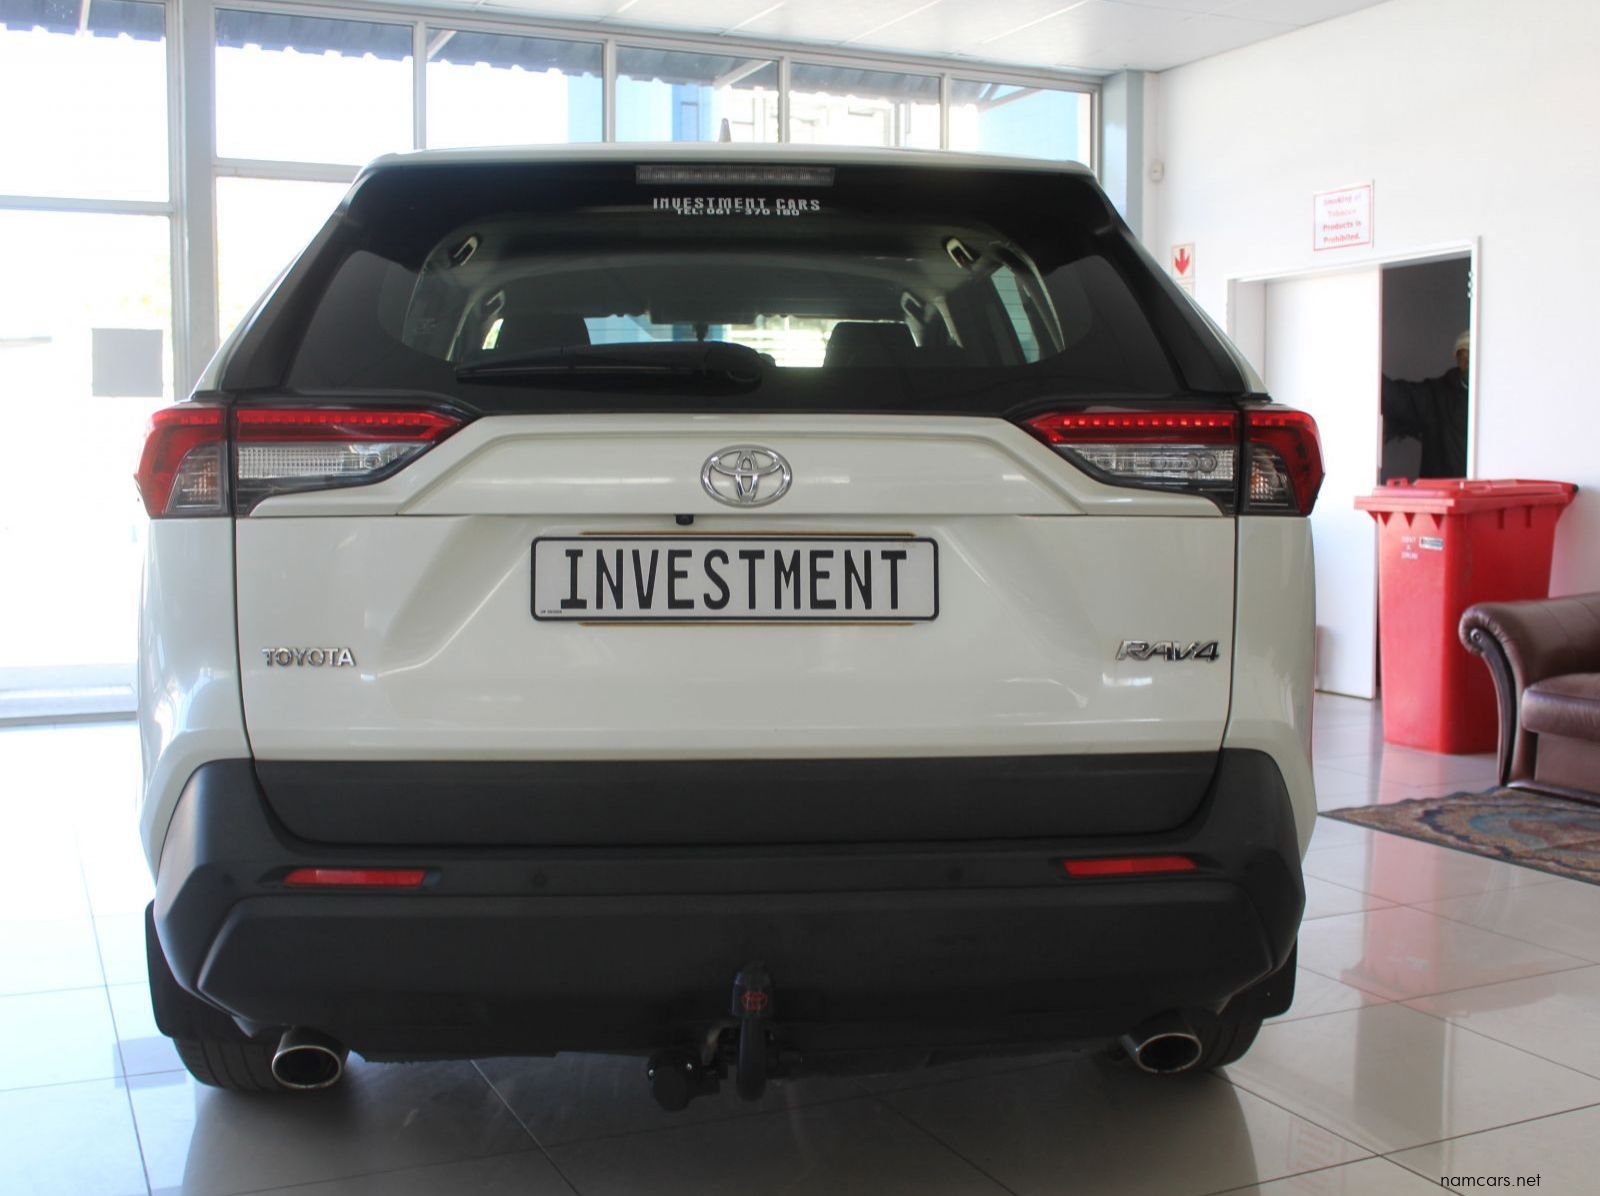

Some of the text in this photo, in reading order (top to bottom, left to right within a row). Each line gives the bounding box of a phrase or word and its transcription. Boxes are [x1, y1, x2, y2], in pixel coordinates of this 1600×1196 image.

[653, 197, 821, 211] INVESTMENT CARS
[560, 549, 908, 610] INVESTMENT
[261, 647, 357, 667] TOYOTA
[1115, 639, 1220, 662] RAV4
